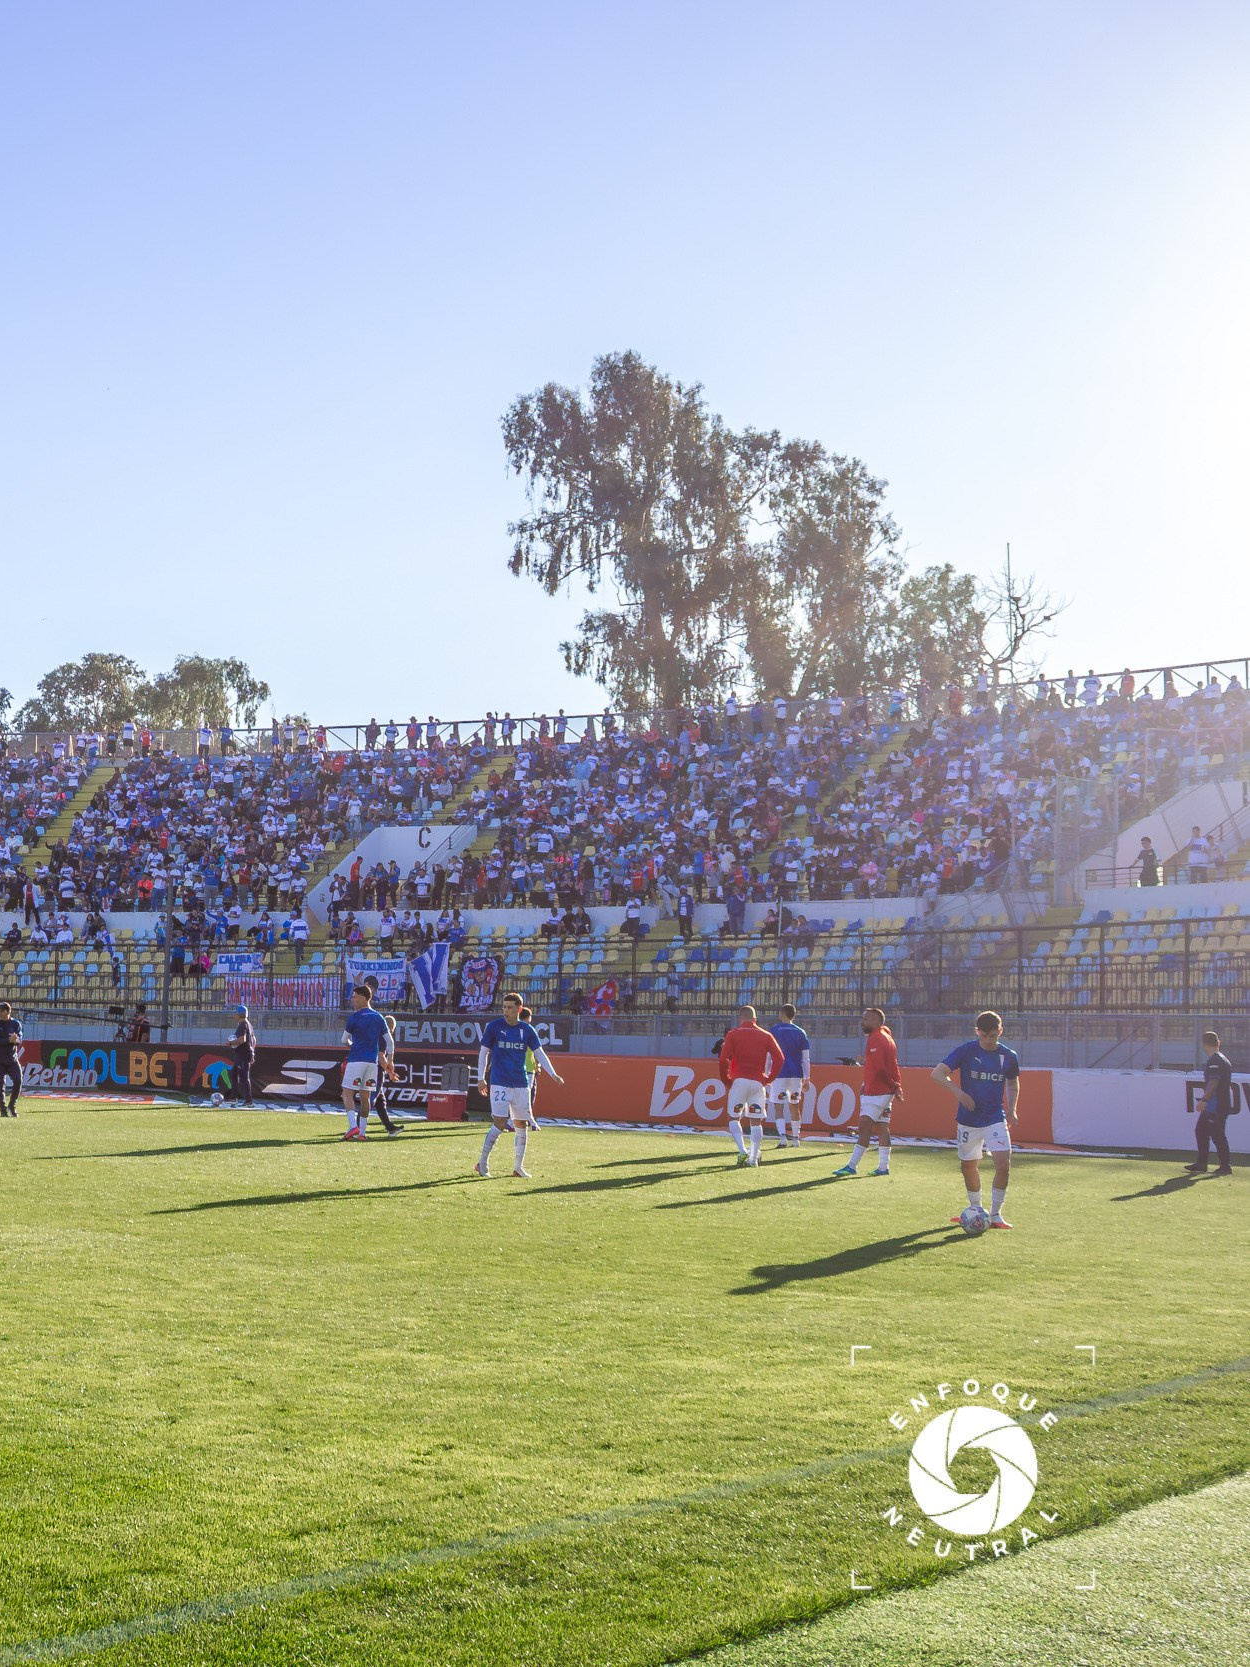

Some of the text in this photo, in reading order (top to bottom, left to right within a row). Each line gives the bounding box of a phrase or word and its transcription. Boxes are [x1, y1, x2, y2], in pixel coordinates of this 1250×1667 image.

[418, 827, 431, 848] C
[506, 1041, 525, 1050] BICE
[23, 1063, 98, 1087] Betano
[980, 1072, 1005, 1082] BICE
[494, 1090, 506, 1101] 22
